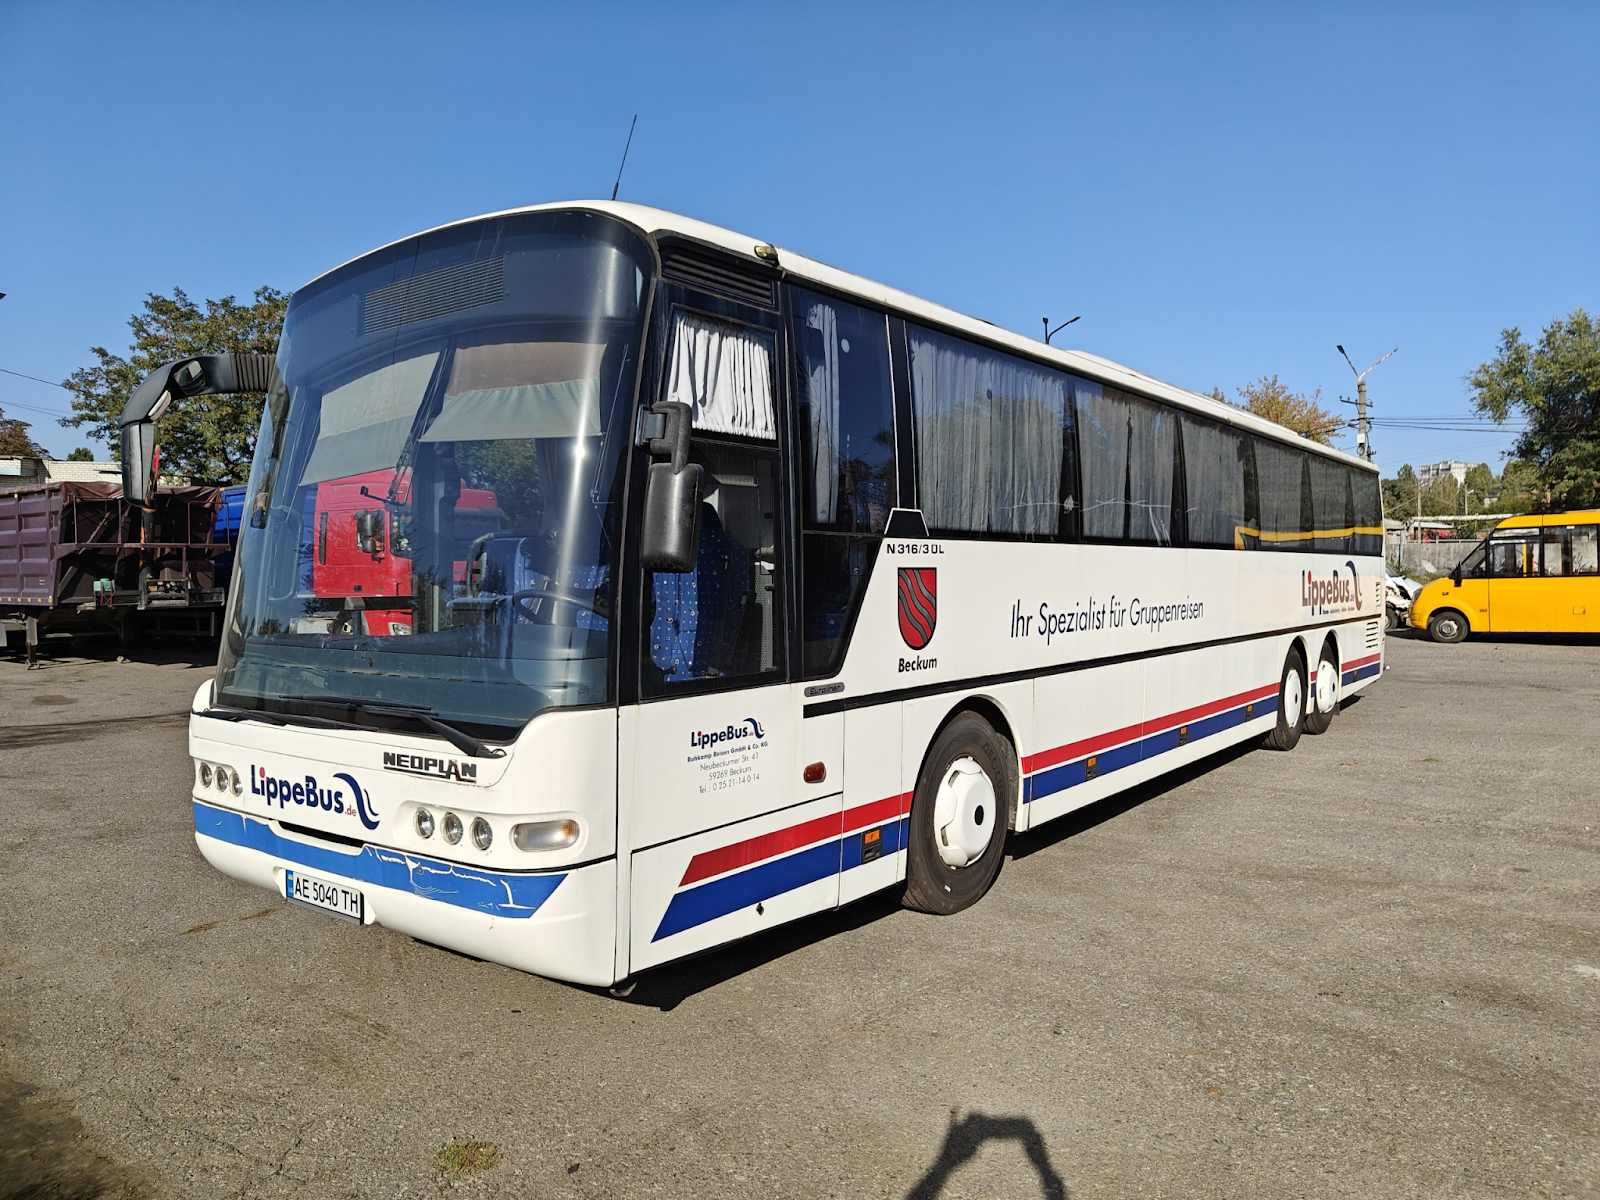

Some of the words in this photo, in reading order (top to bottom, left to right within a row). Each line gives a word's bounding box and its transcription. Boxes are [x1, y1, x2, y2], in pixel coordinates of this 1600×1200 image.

[886, 543, 895, 555] N
[1010, 598, 1034, 639] Ihr
[1038, 596, 1106, 646] Spezialist
[1109, 594, 1127, 629] für
[1129, 595, 1204, 633] Gruppenreisen
[898, 656, 938, 673] Beckum
[687, 752, 712, 763] Ruhkamp
[713, 749, 730, 758] Reisen
[730, 745, 747, 754] GmbH
[760, 740, 769, 748] KG
[699, 757, 741, 772] Neubeckumer
[751, 751, 759, 760] 41
[383, 751, 478, 782] NEOPLAN
[708, 769, 729, 781] 59269
[729, 765, 752, 777] Beckum
[752, 772, 760, 782] 14
[294, 876, 310, 899] AE
[312, 881, 339, 907] 5040
[340, 889, 359, 914] TH
